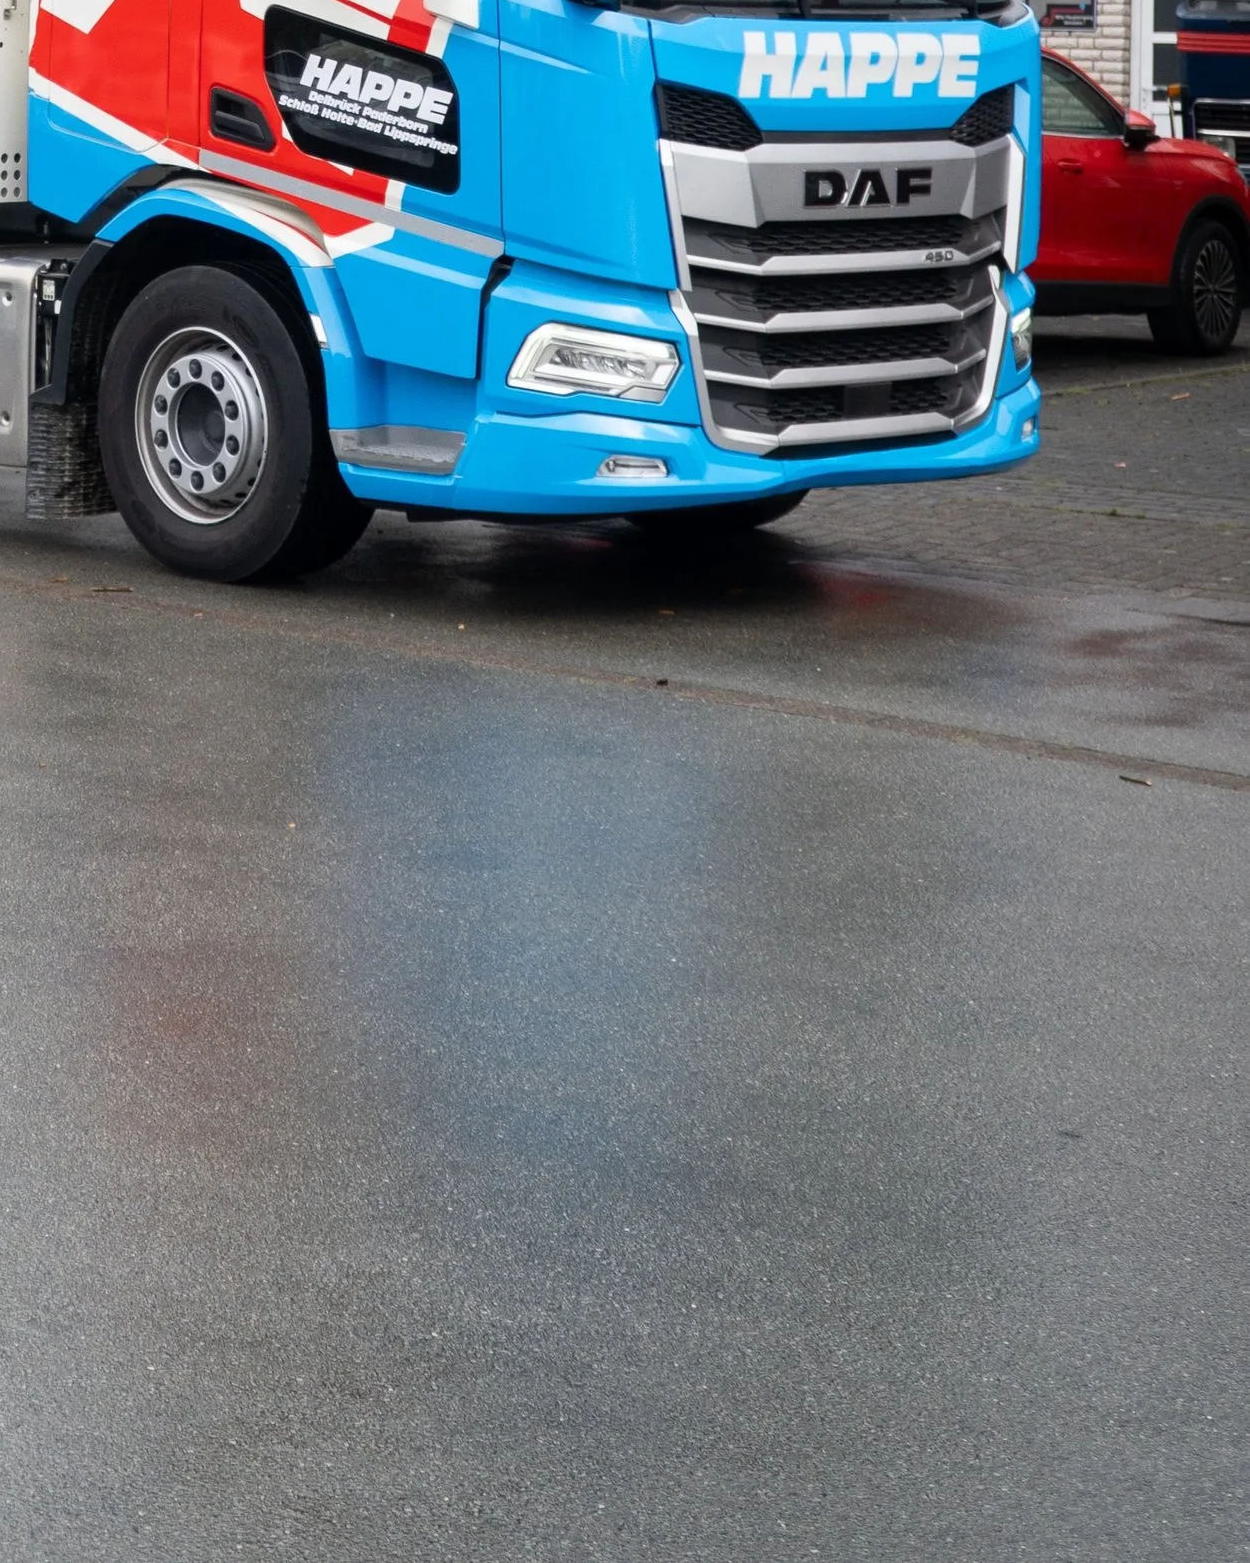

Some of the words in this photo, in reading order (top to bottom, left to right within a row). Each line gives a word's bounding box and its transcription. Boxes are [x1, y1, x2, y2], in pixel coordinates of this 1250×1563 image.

[300, 54, 454, 125] HAPPE
[738, 31, 980, 98] HAPPE
[278, 94, 320, 116] Schloß
[383, 125, 459, 156] Lippspringe
[308, 90, 361, 115] Delbrück
[362, 106, 429, 134] Paderborn
[804, 167, 933, 207] DAF
[925, 250, 954, 263] 450
